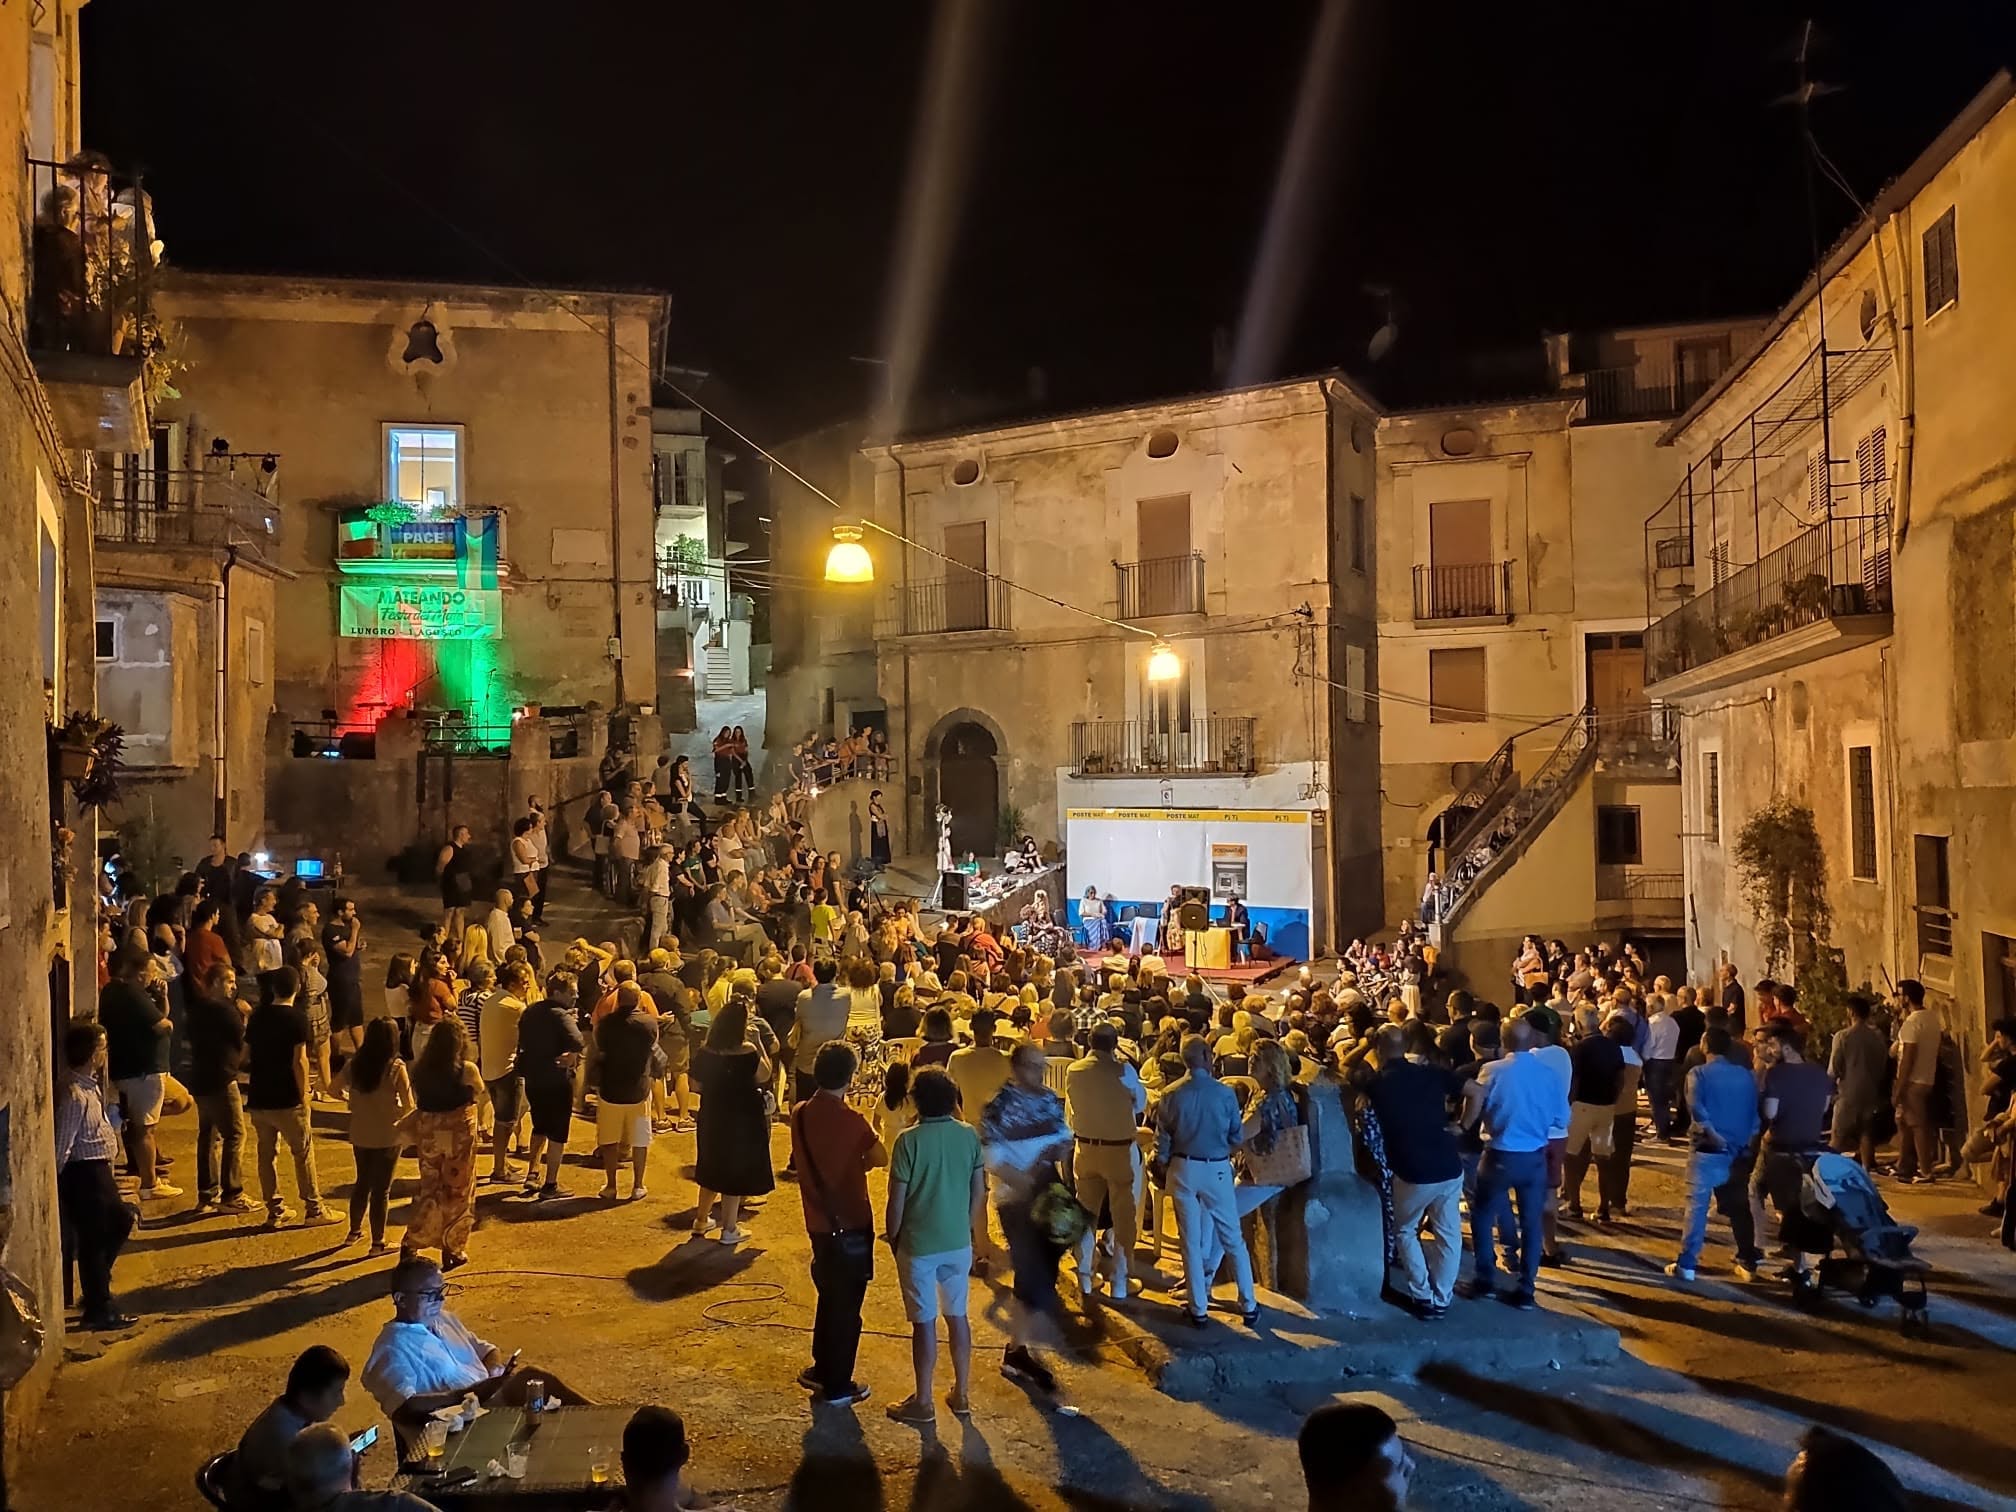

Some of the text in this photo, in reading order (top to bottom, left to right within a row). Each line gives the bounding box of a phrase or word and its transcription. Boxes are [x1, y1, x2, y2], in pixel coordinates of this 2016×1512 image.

[403, 532, 444, 544] PACE
[377, 591, 466, 605] MATEANDO
[351, 627, 395, 636] LUNGRO
